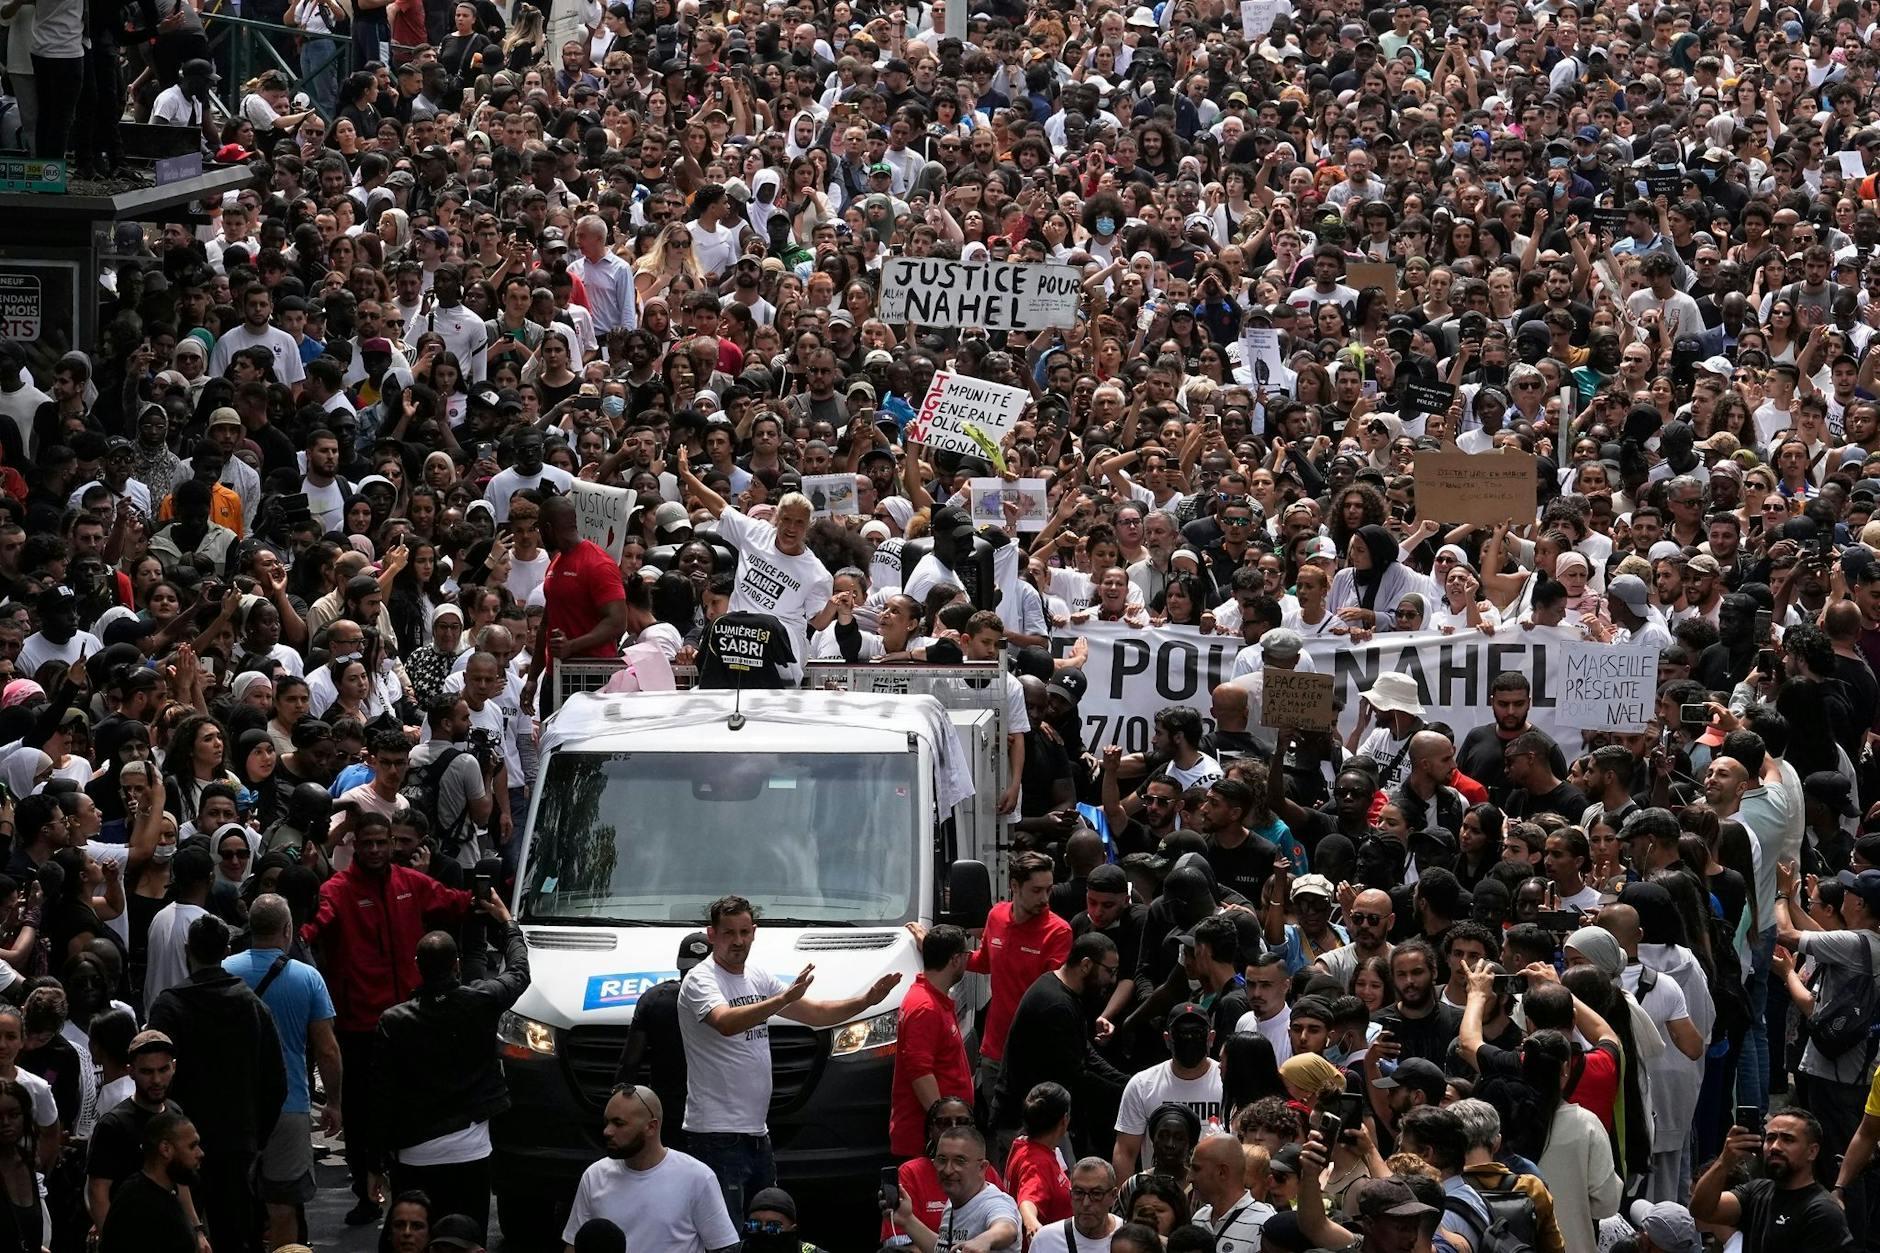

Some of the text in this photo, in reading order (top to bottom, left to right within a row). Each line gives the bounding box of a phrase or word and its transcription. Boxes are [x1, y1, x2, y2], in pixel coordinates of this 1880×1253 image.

[894, 261, 1079, 296] JUSTICE POUR
[883, 288, 904, 299] ALLAH
[889, 301, 895, 309] Y
[4, 305, 38, 316] MOIS
[904, 288, 1027, 328] NAHEL
[931, 374, 1013, 408] IMPUNITÉ
[1416, 398, 1437, 407] POLICE
[924, 393, 1007, 428] GÉNÉRALE
[585, 516, 604, 530] POUR
[746, 569, 783, 598] NAHEL
[747, 554, 801, 592] JUSTICE POUR
[740, 583, 776, 610] 27/06/23
[714, 624, 770, 643] LUMIÈRE[S]
[719, 637, 764, 657] SABRI
[1334, 643, 1557, 707] NAHEL
[1567, 653, 1653, 679] MARSEILLE
[1566, 676, 1640, 701] PRÉSENTE
[501, 706, 518, 717] OUR
[1606, 702, 1650, 725] NAEL
